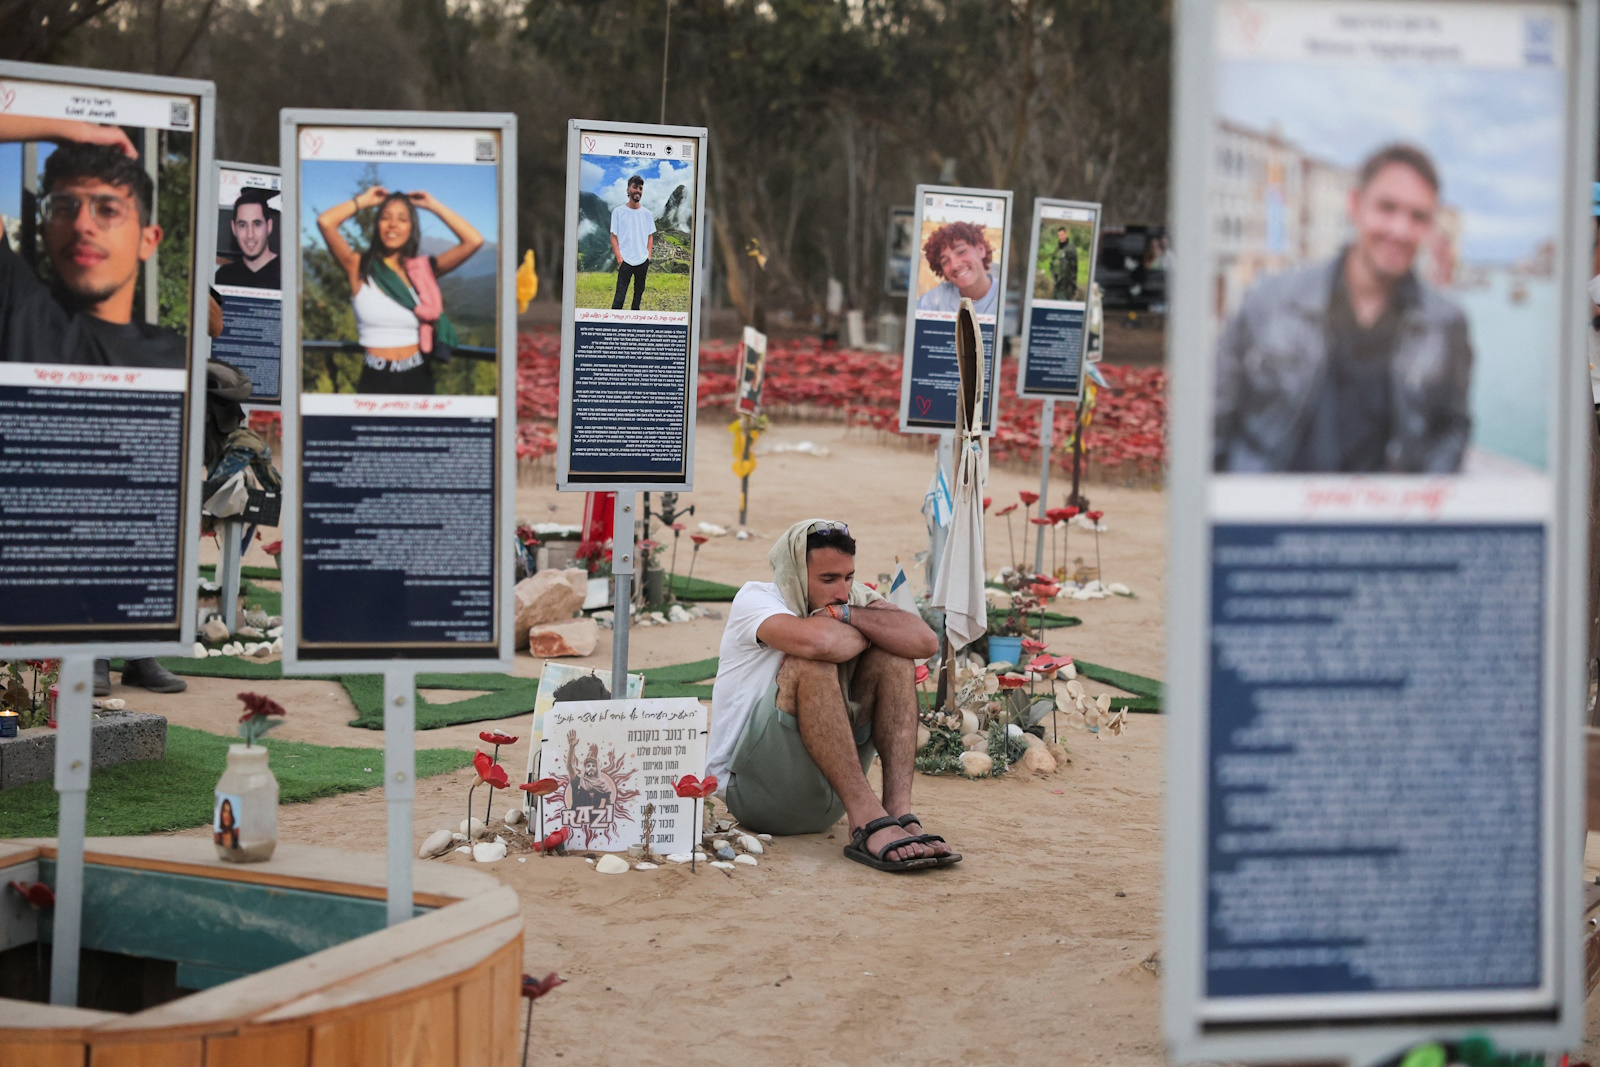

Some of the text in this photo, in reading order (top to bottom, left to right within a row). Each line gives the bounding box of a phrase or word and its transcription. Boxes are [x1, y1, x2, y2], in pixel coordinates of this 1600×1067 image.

[390, 352, 424, 373] NIKE
[628, 729, 660, 742] בוקובזה
[688, 728, 696, 740] רז
[637, 744, 686, 756] מלך העולם שלנו
[665, 760, 679, 770] המון
[644, 776, 659, 786] איתך
[645, 790, 674, 800] המון ממך
[659, 804, 679, 814] ממשיך
[561, 804, 614, 828] RAZI
[656, 834, 674, 843] ונאהב
